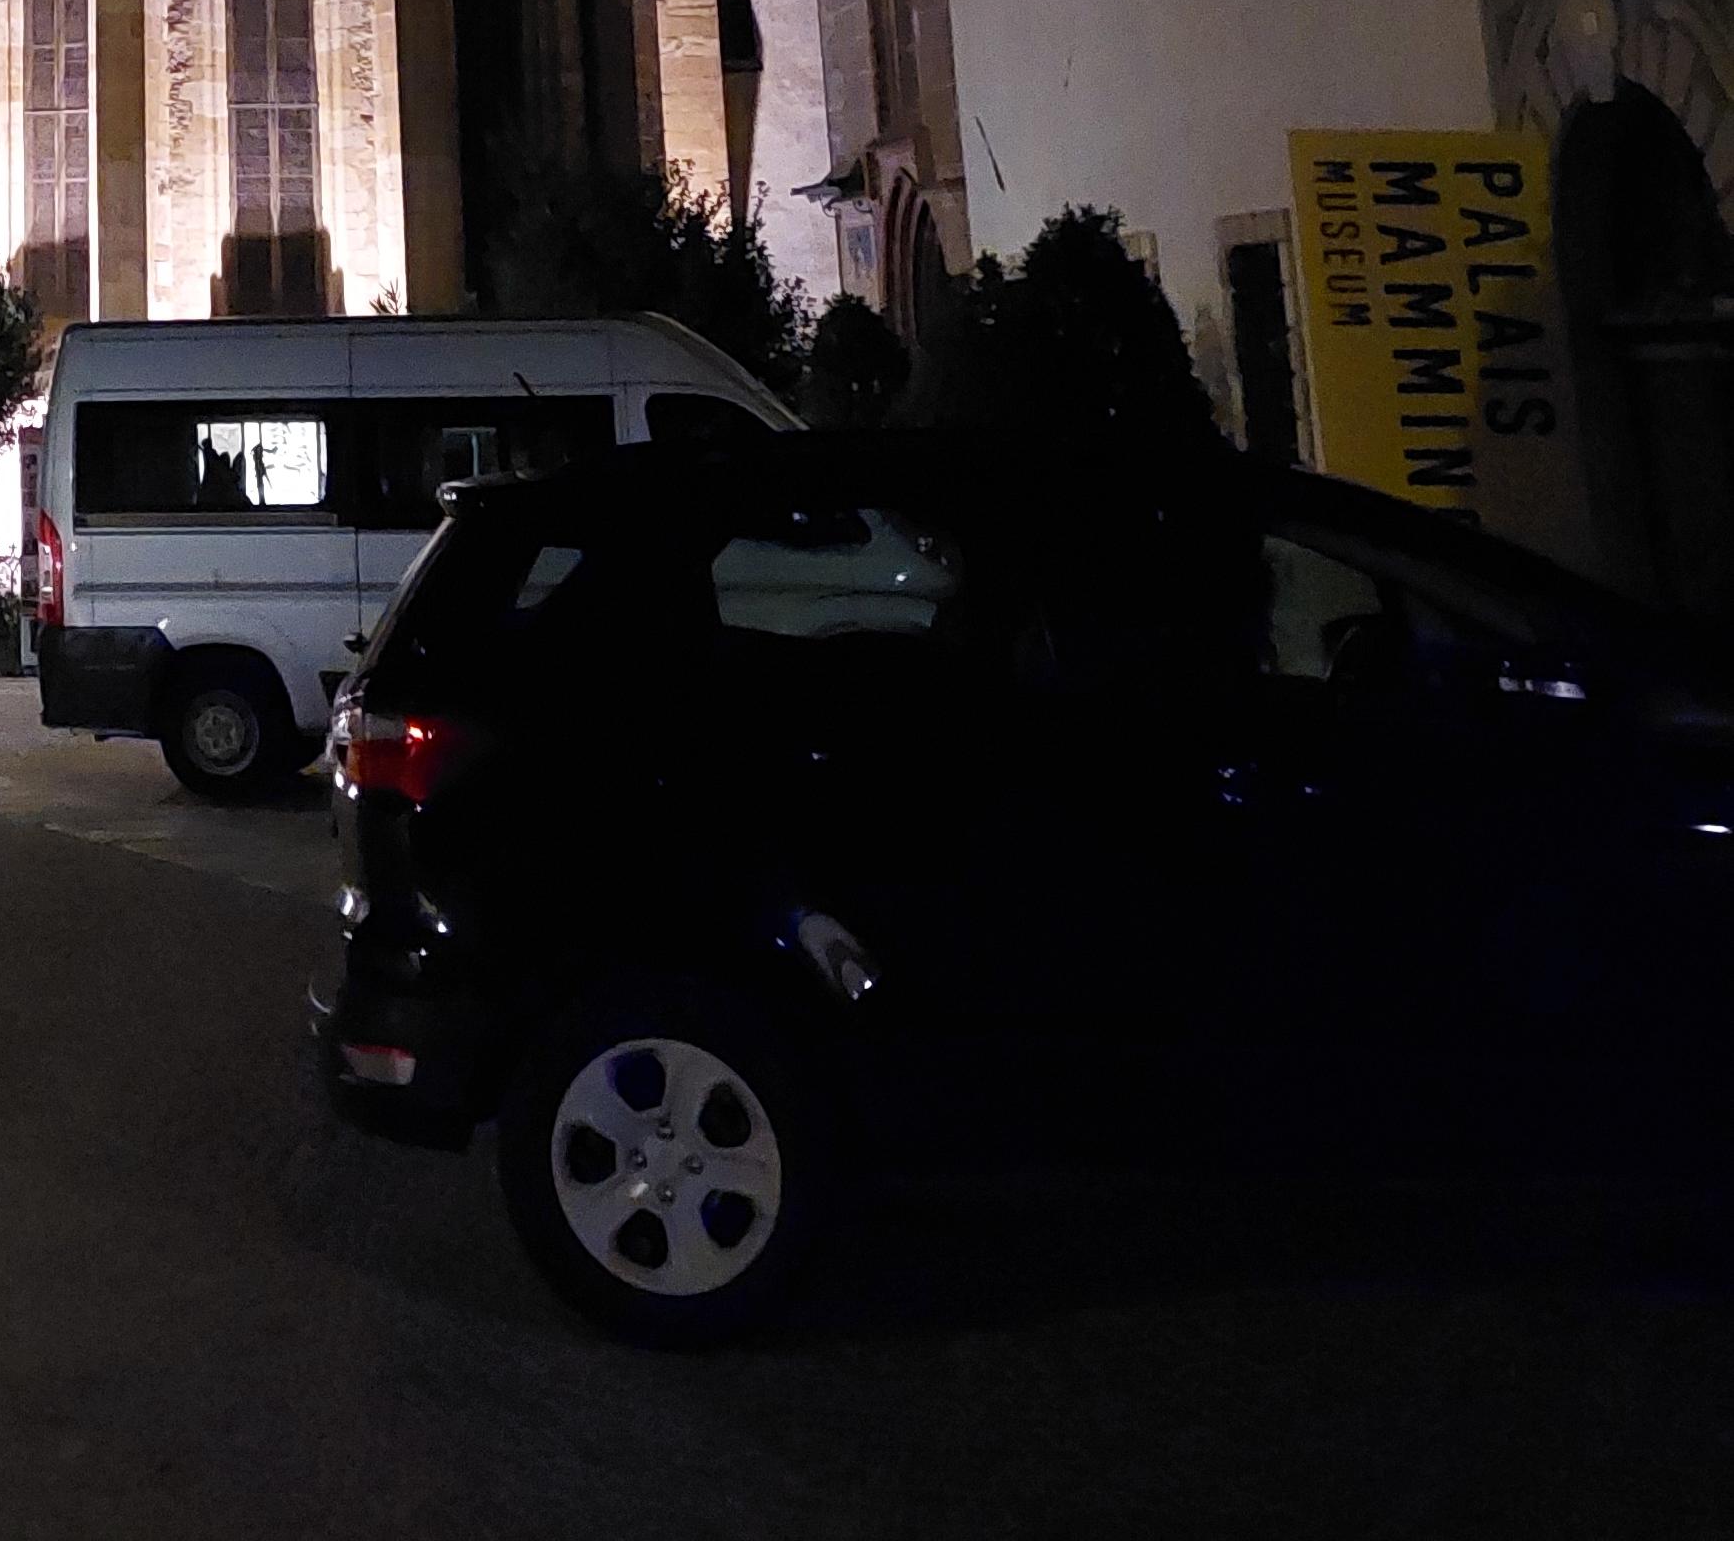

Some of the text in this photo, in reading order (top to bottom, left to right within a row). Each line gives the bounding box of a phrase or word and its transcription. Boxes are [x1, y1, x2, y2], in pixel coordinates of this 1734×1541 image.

[1312, 159, 1372, 327] MUSEUM
[1368, 160, 1482, 531] MAMMIN
[1453, 160, 1556, 436] PALAIS
